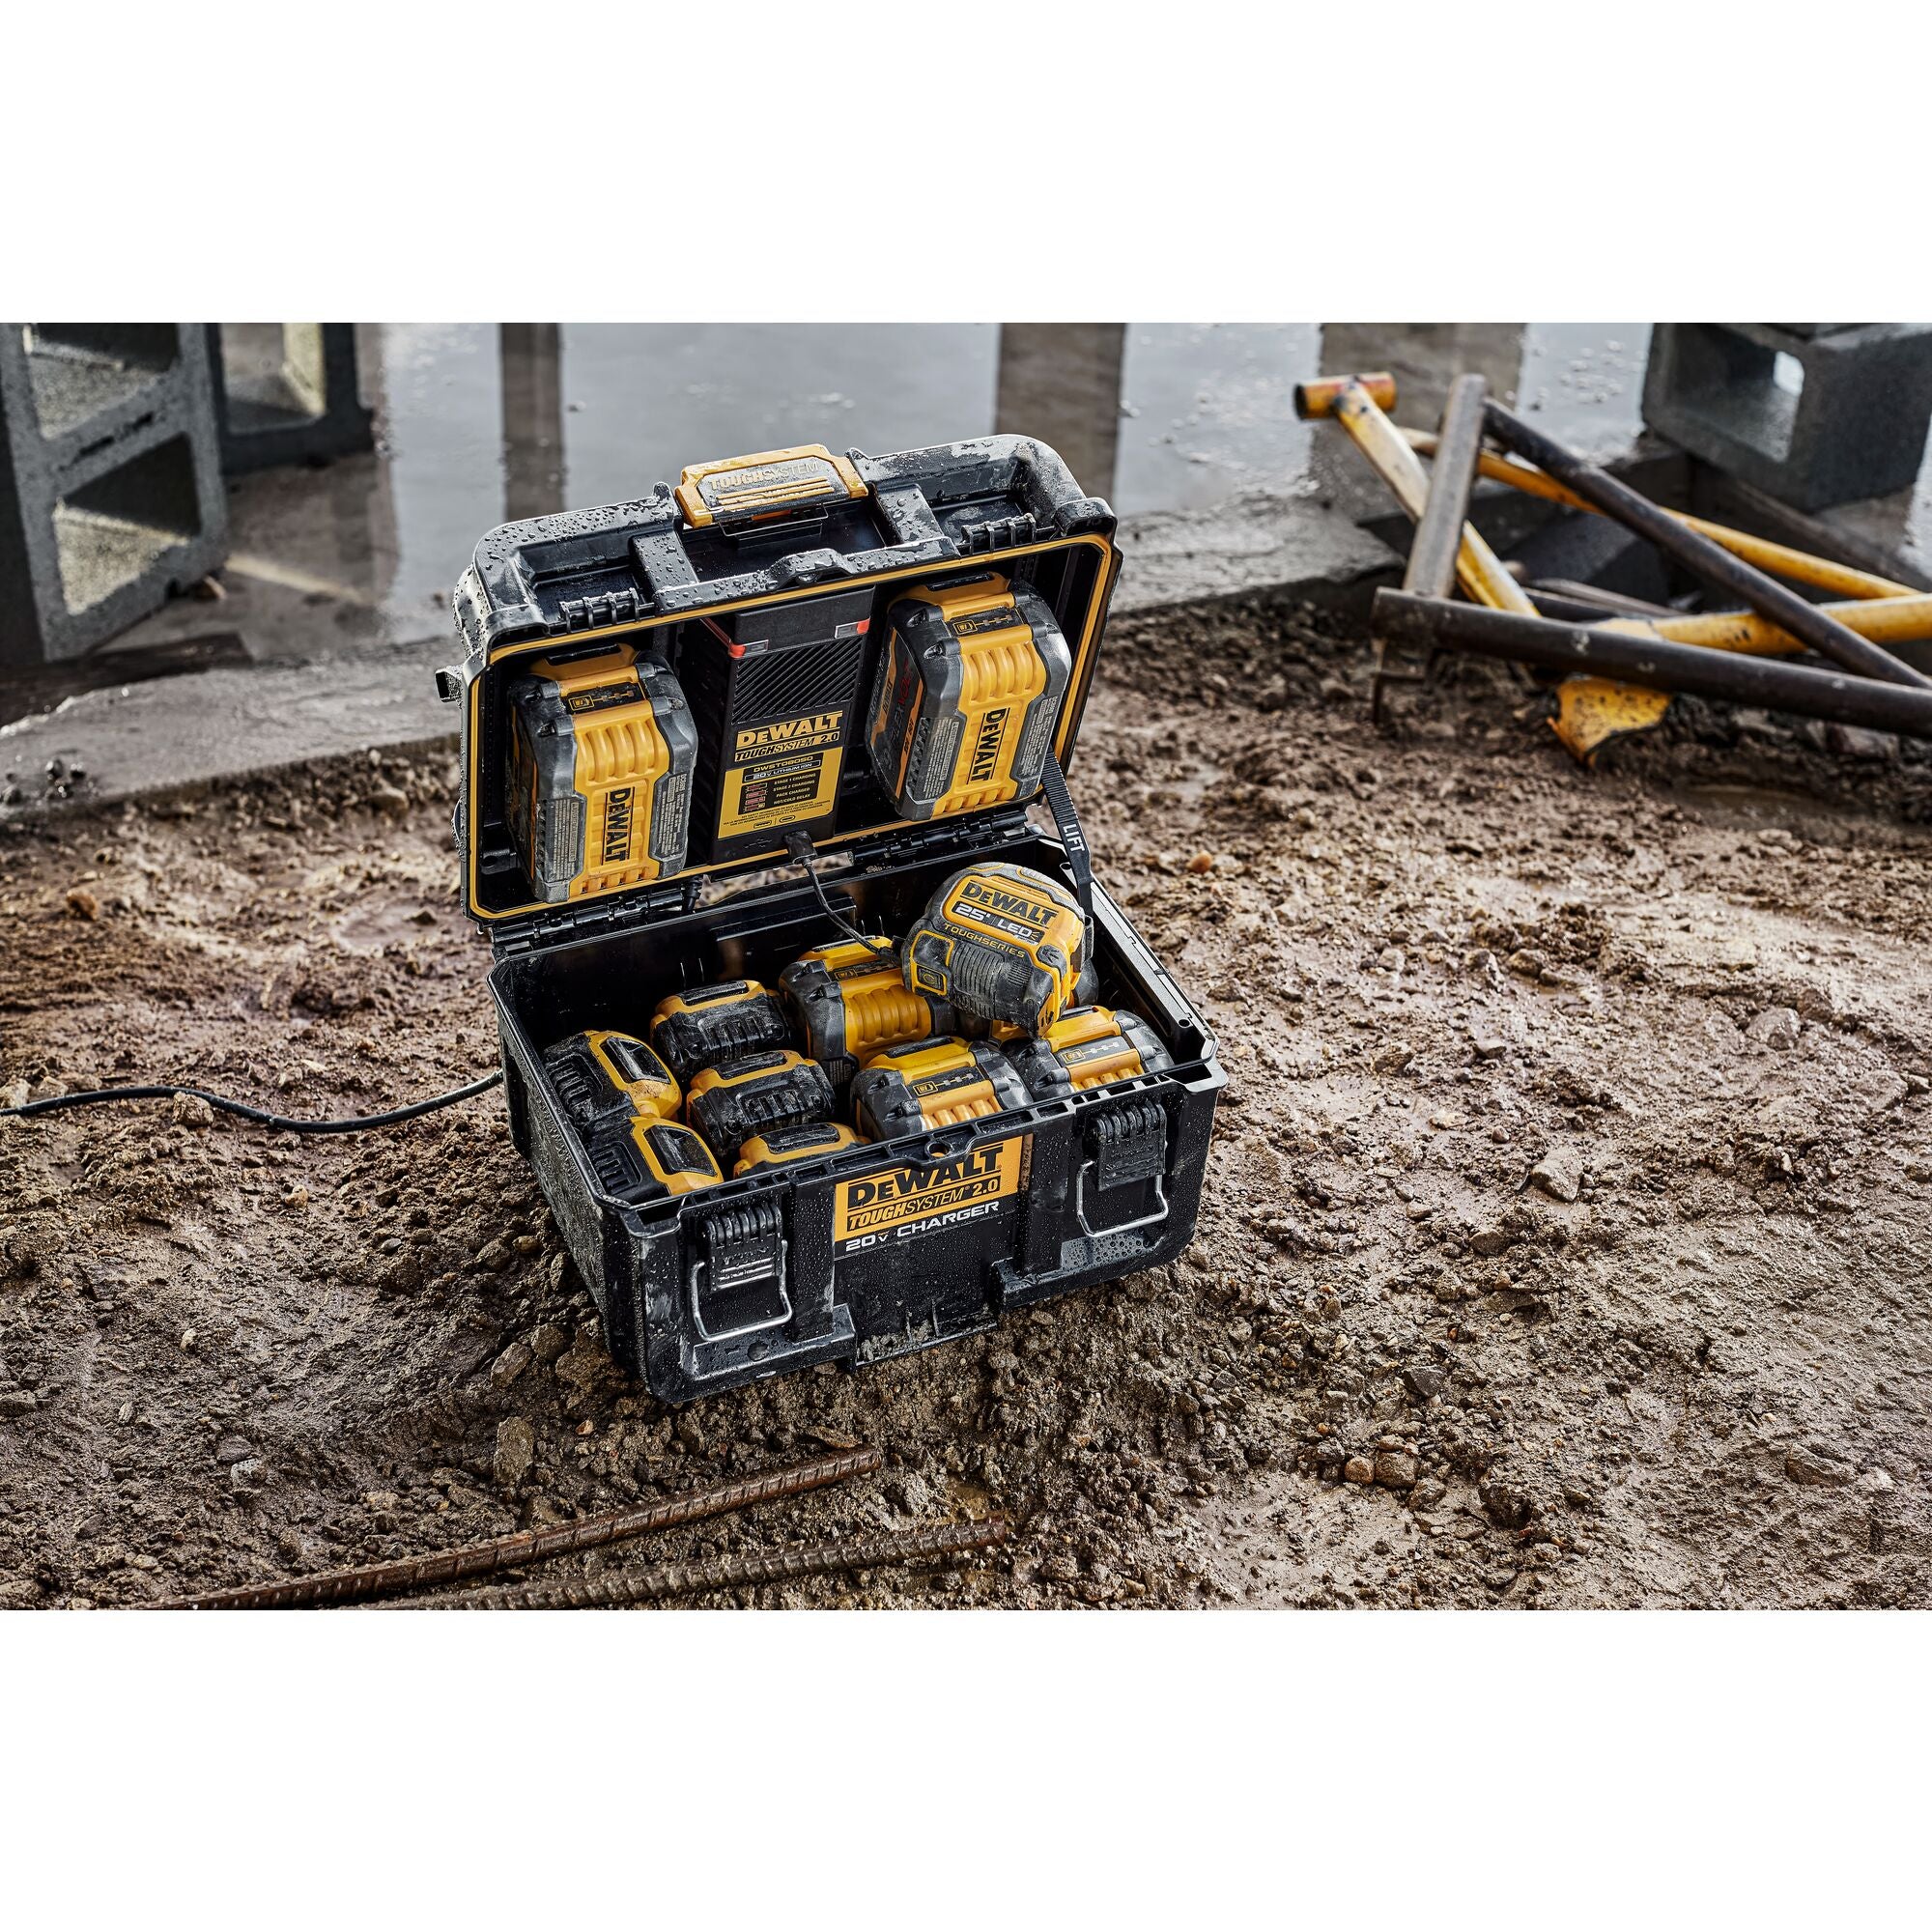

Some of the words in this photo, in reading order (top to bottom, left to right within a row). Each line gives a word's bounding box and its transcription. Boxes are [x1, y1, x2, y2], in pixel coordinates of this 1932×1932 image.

[711, 461, 819, 491] TOUGHSYSTEM
[736, 712, 843, 749] DEWALT
[736, 737, 815, 761] TOUGHSYSTEM
[820, 732, 838, 744] 2.0
[971, 708, 1007, 782] DEWALT
[605, 787, 632, 862] DEWALT
[1063, 823, 1085, 852] LIFT
[960, 882, 1057, 927] DEWALT
[944, 923, 1026, 958] TOUGHSERIES
[998, 922, 1033, 937] LED
[848, 1146, 1003, 1208] DEWALT
[849, 1189, 963, 1230] TOUGHSYSTEM
[973, 1179, 998, 1196] 2.0
[896, 1201, 1000, 1237] CHARGER
